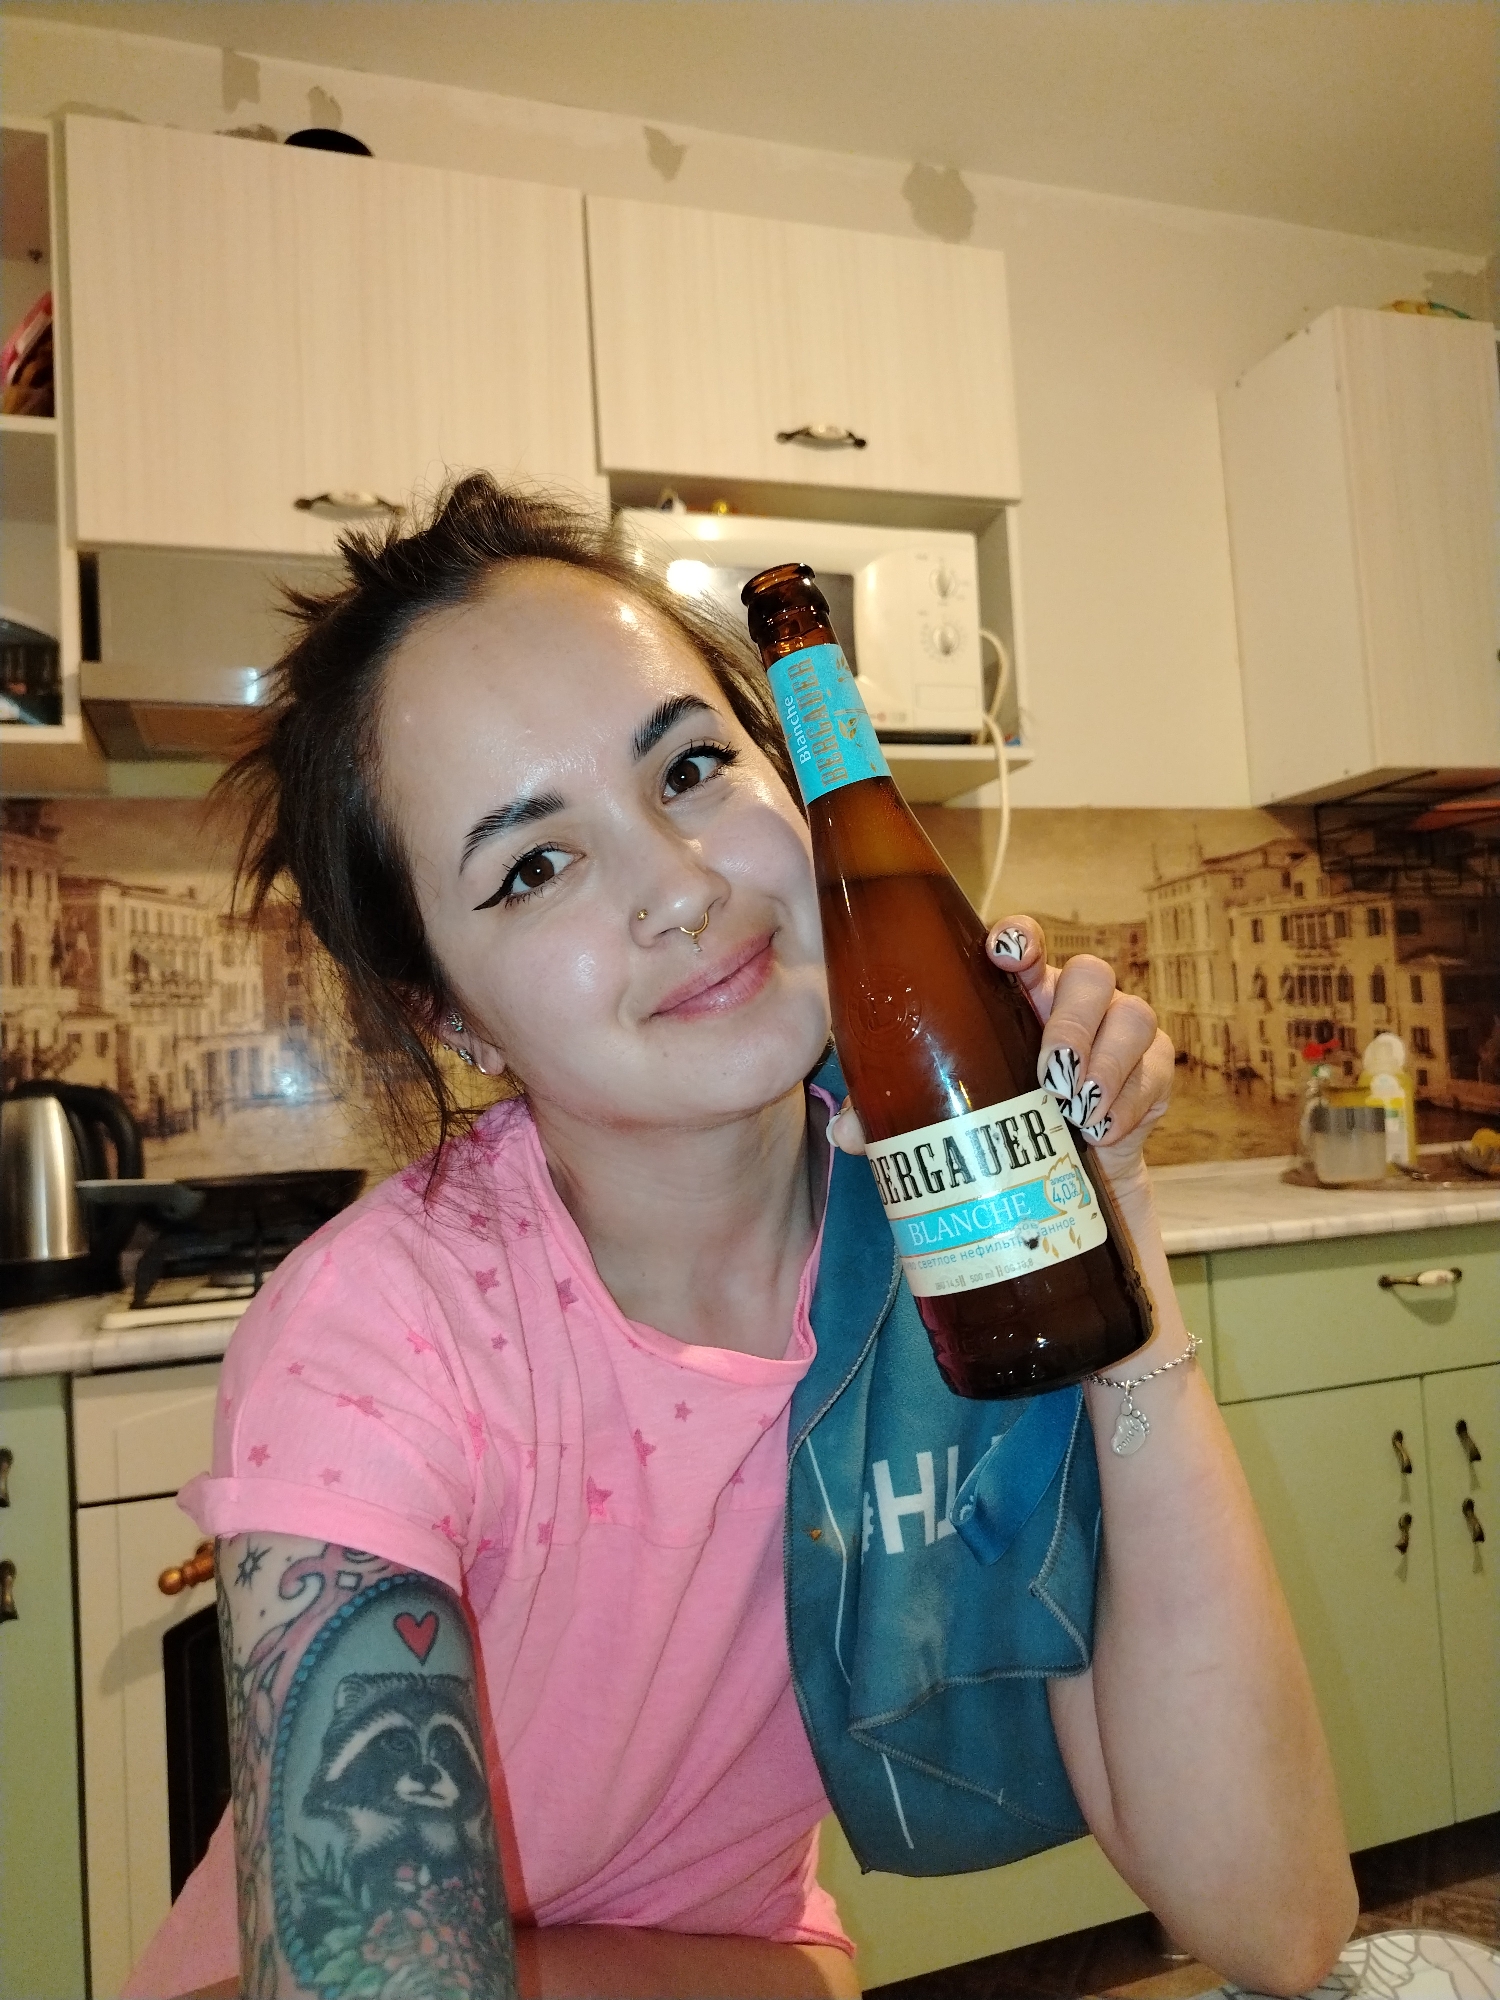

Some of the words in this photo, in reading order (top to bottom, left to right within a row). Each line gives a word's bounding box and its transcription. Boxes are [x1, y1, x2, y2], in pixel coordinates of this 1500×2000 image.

[784, 695, 812, 765] Blanche
[908, 1192, 1032, 1246] BLANCHE
[918, 1254, 957, 1269] светлое
